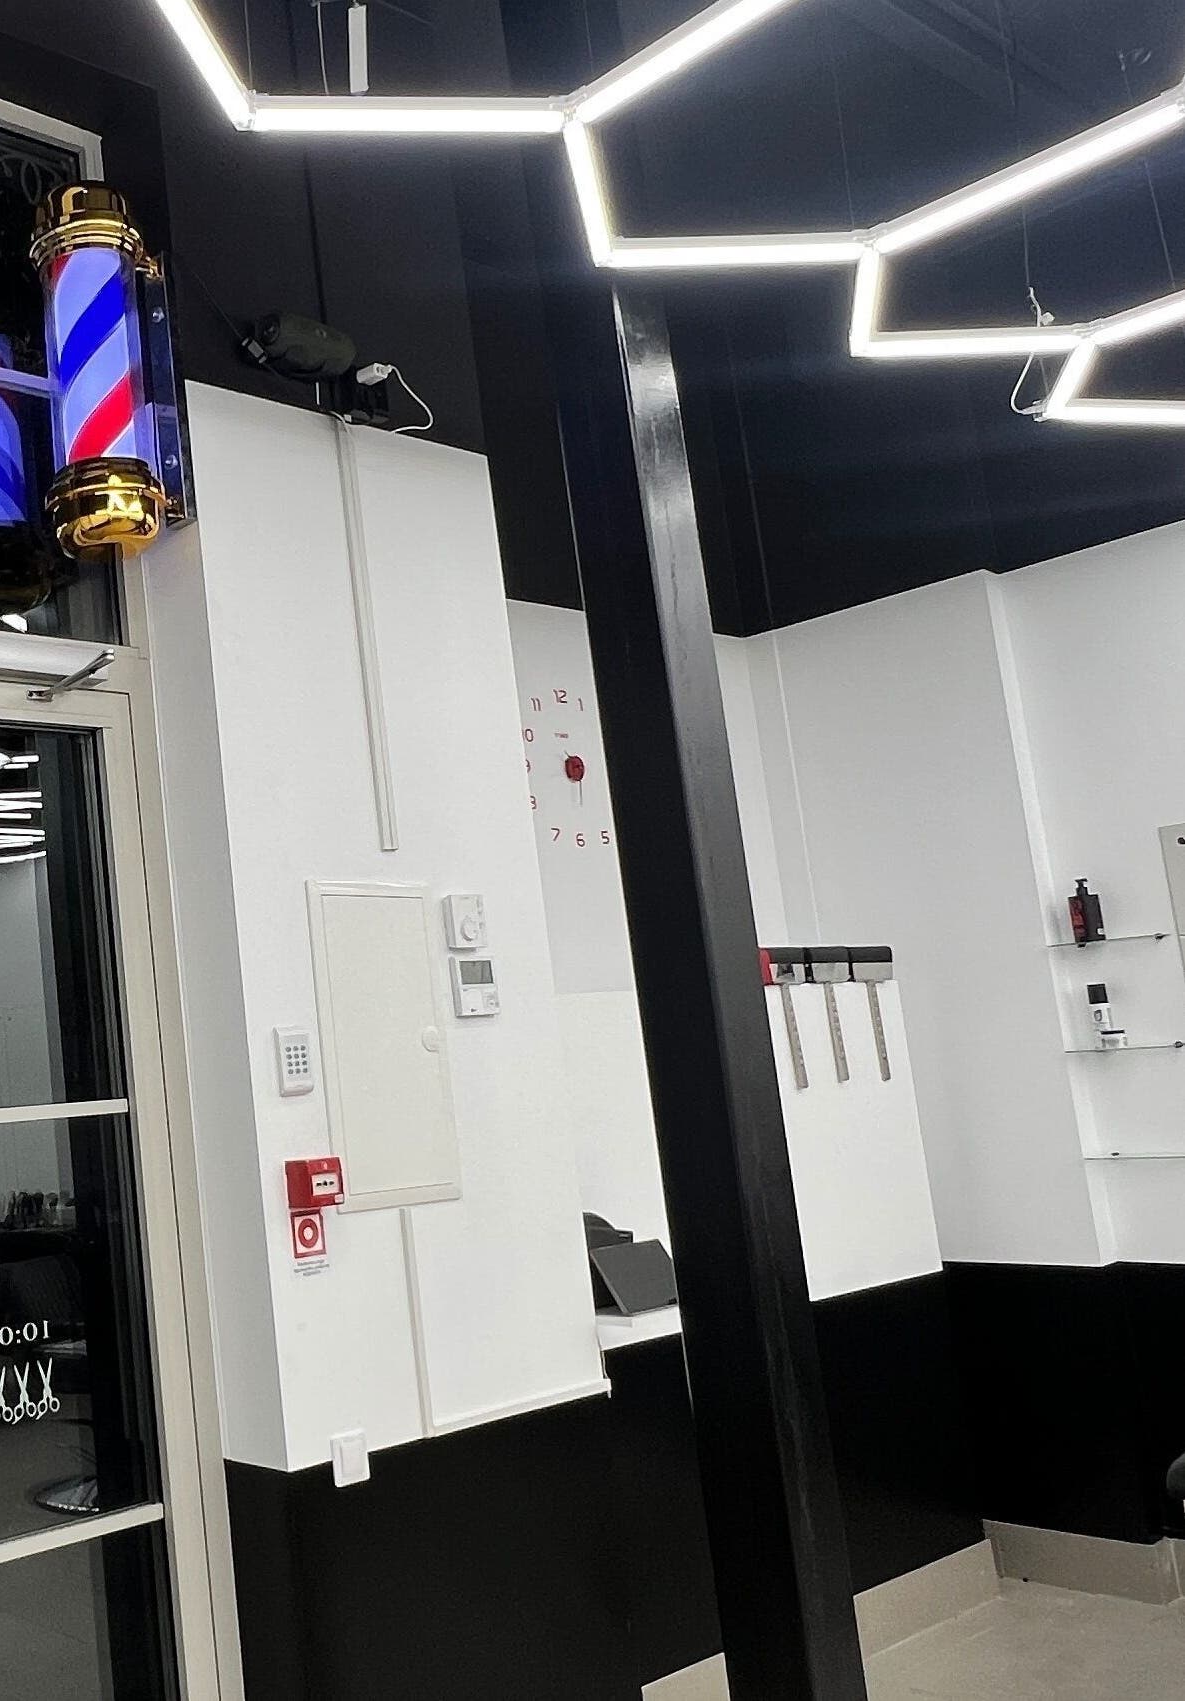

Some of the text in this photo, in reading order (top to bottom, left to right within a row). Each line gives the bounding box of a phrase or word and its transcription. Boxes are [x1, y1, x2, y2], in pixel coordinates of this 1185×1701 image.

[553, 689, 567, 703] 12
[531, 697, 541, 711] 11
[578, 698, 584, 711] 1
[551, 827, 560, 841] 7
[576, 833, 585, 847] 6
[600, 830, 610, 844] 5
